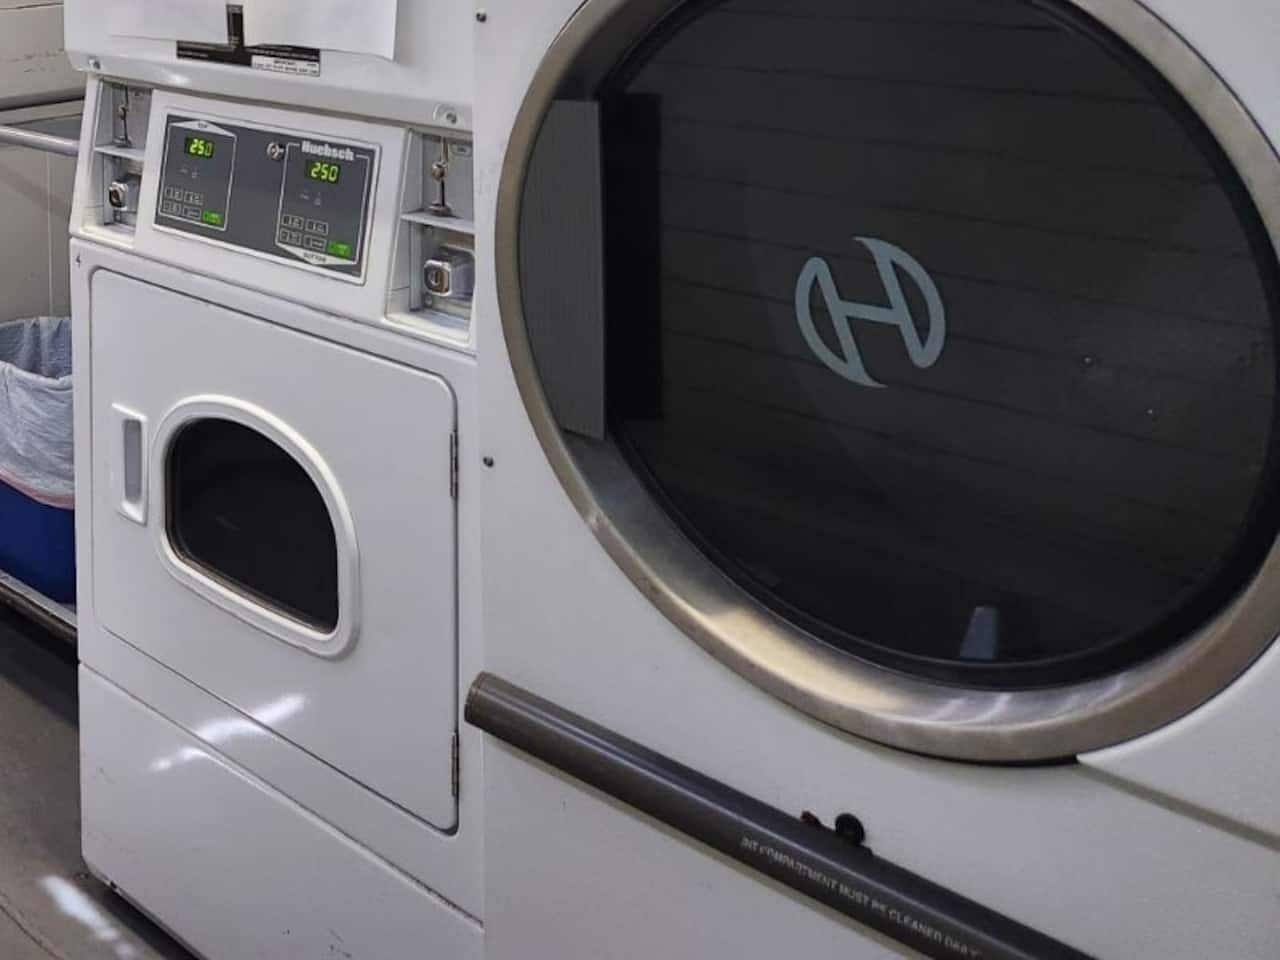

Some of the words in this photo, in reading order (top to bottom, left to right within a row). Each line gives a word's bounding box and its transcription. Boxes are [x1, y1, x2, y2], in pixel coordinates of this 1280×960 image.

[189, 138, 213, 156] 250
[301, 140, 354, 161] Huebsch
[310, 162, 339, 182] 250
[839, 883, 870, 907] MUST
